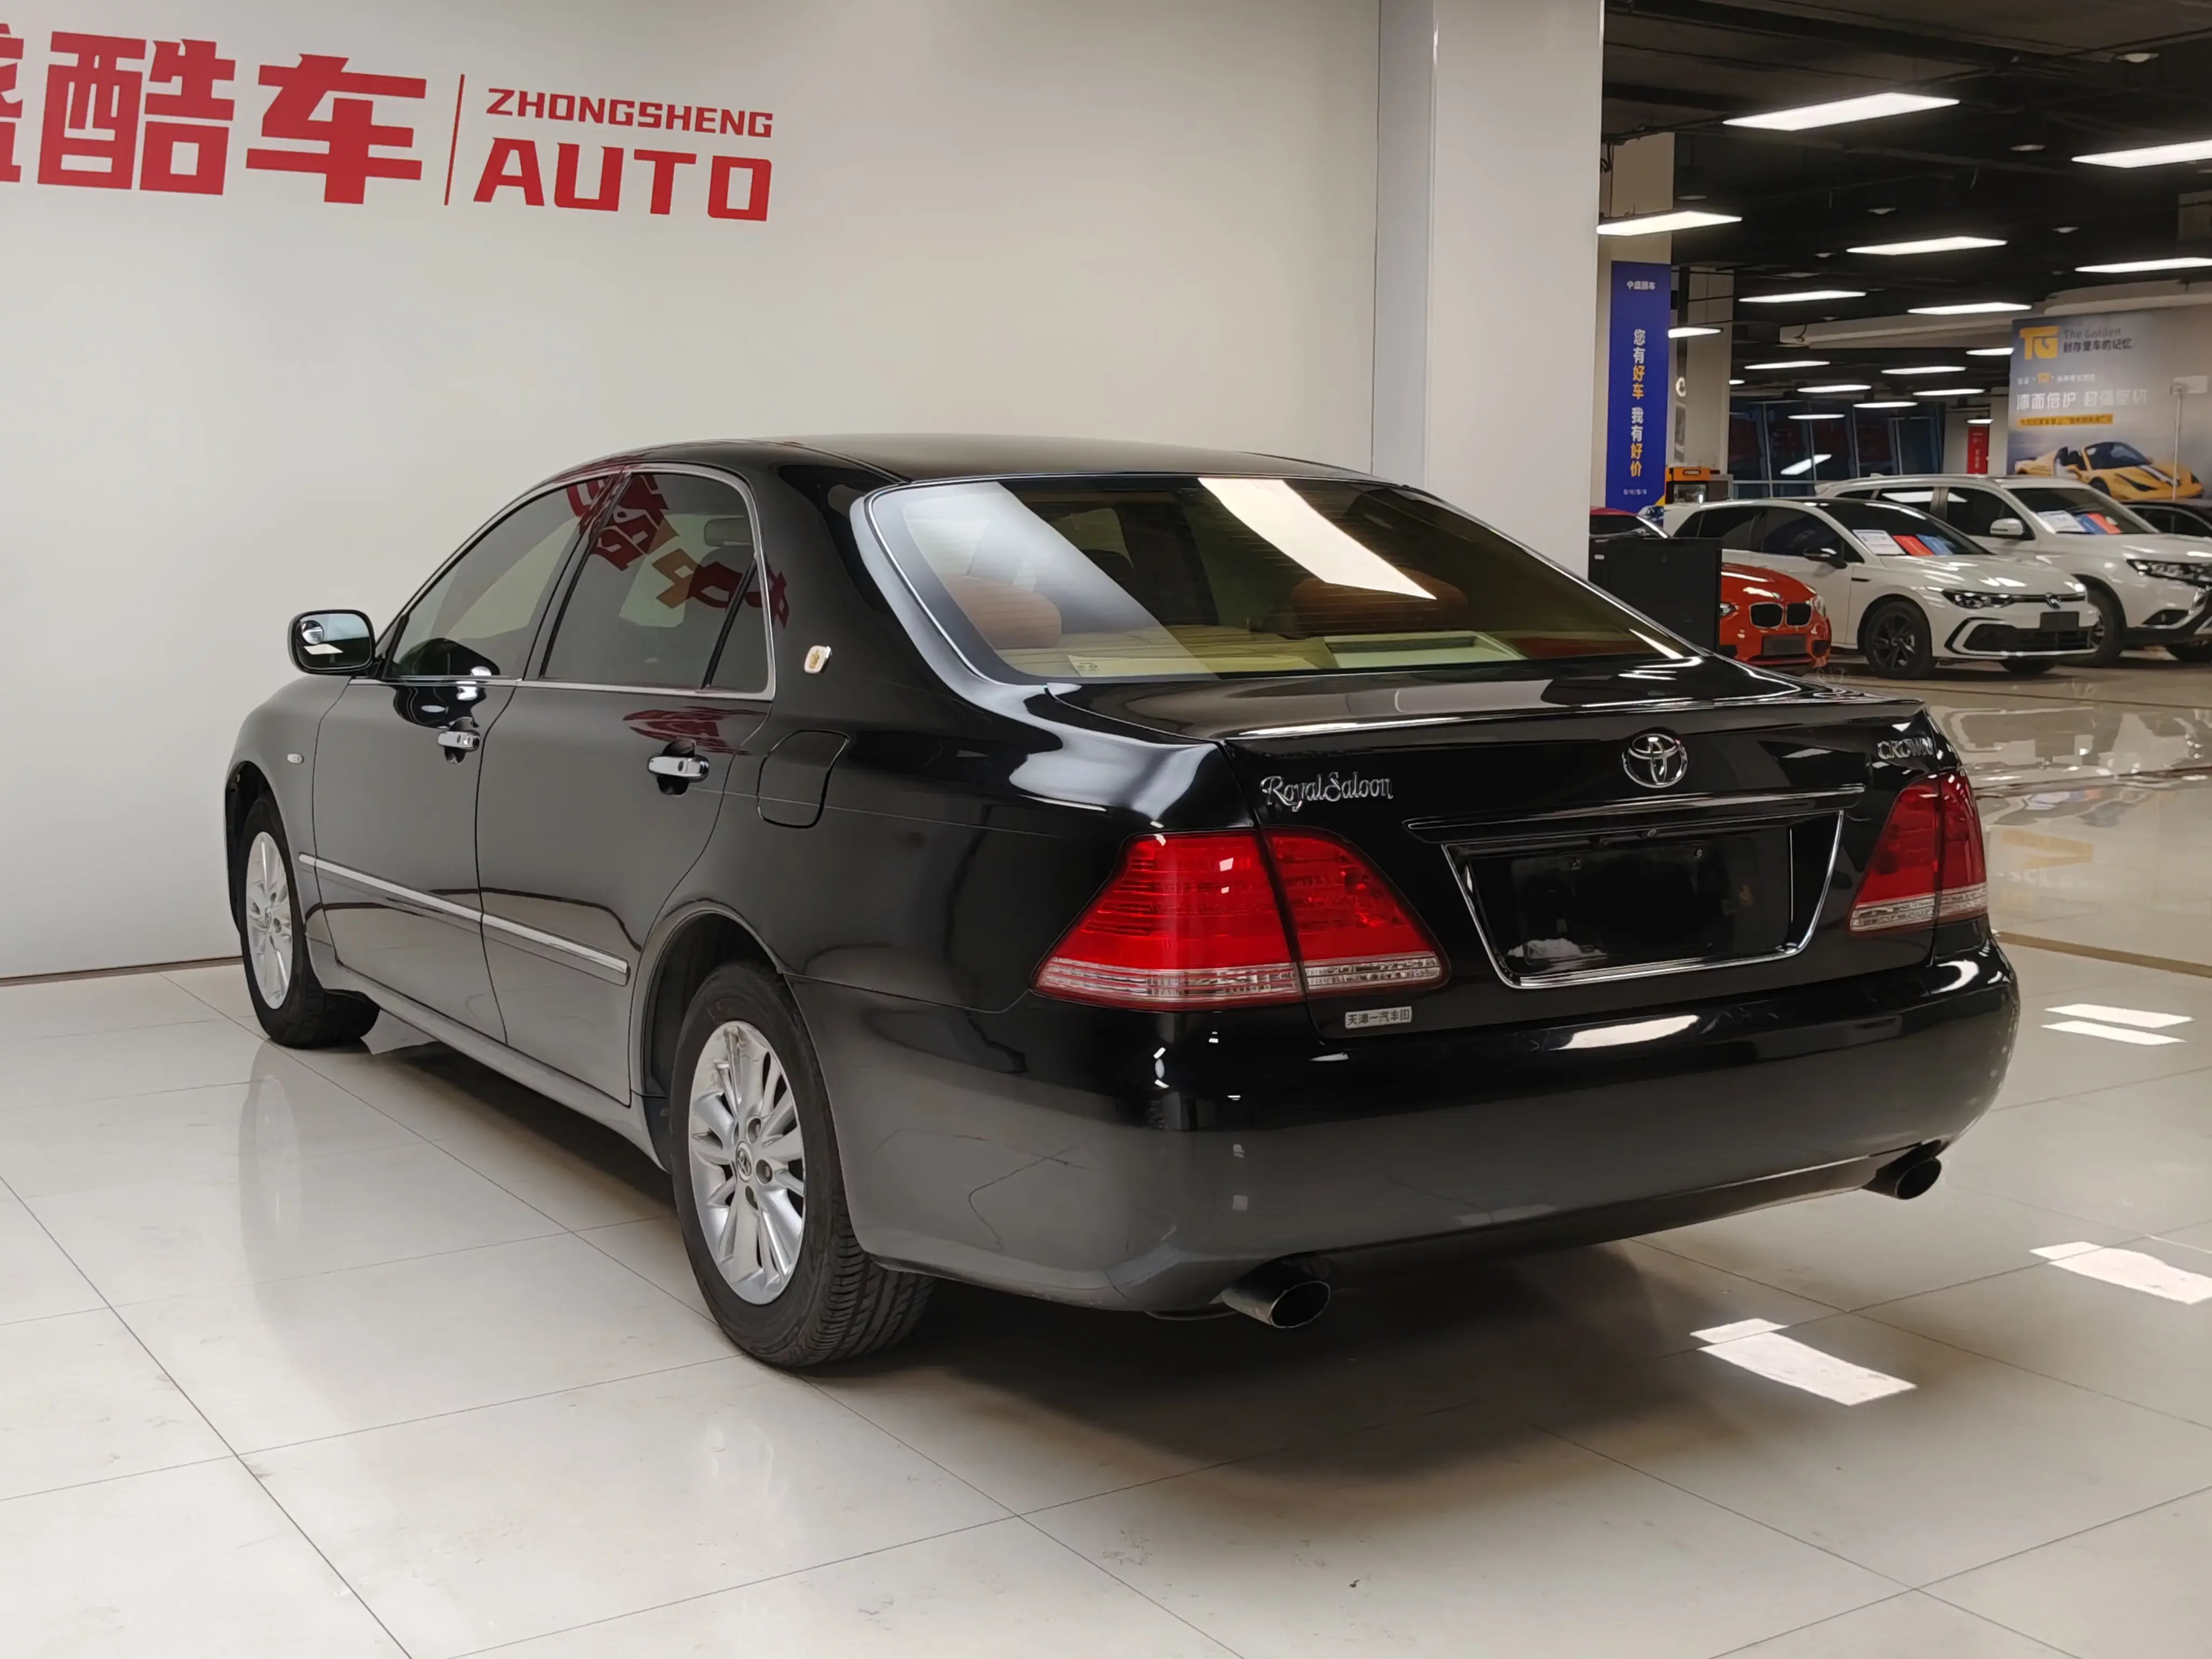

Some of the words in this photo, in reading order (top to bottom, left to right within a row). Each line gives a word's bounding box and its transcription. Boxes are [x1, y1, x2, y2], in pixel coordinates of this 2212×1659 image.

[0, 24, 426, 204] 酷车
[487, 89, 773, 137] ZHONGSHENG
[474, 138, 772, 221] AUTO
[1633, 328, 1645, 400] 您有好车
[2063, 329, 2082, 340] The
[1630, 407, 1644, 477] 我有好价
[1878, 737, 1935, 759] CROWN
